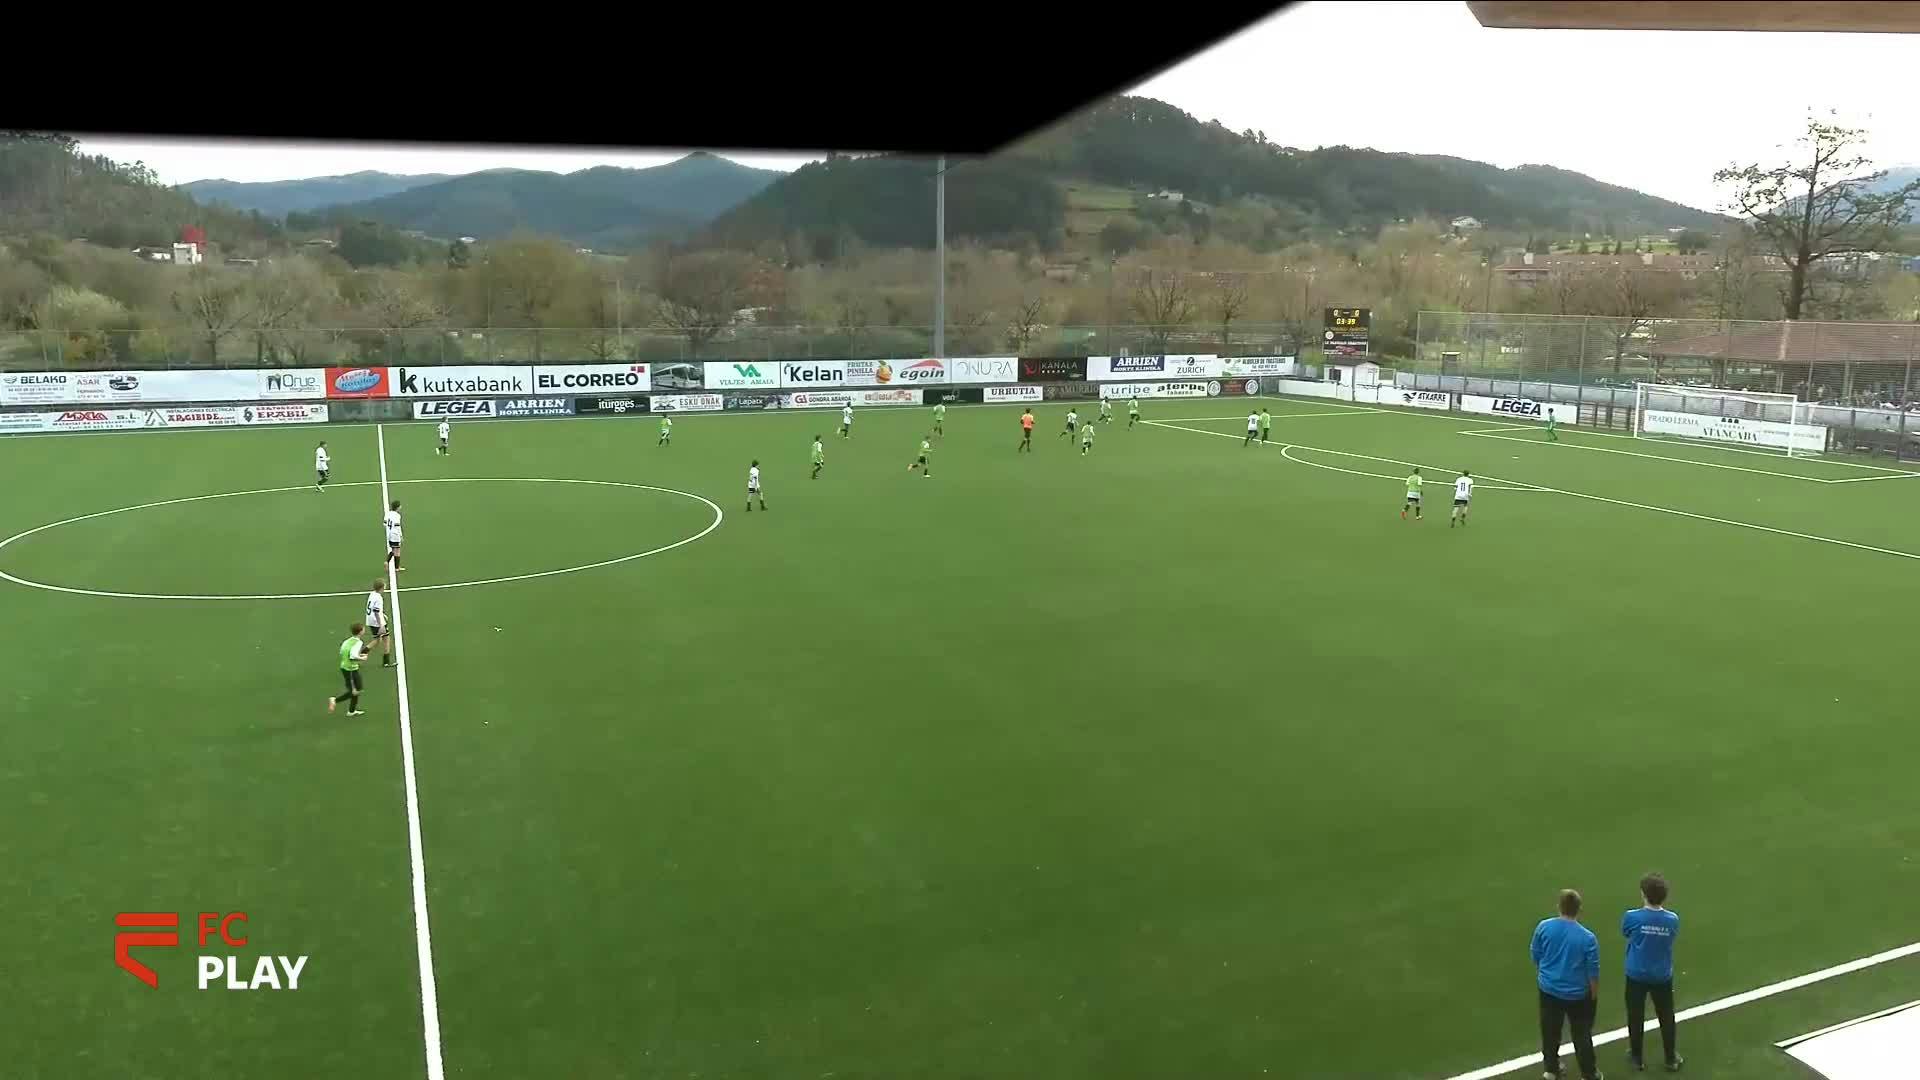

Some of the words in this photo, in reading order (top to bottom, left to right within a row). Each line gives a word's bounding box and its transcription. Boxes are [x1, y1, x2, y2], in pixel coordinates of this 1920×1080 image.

[1041, 361, 1078, 369] KANALA
[1116, 356, 1160, 366] ARRIEN
[790, 366, 843, 382] Kelan
[899, 366, 945, 381] egoin
[1176, 366, 1206, 374] ZURICH
[21, 375, 67, 384] BELAKO
[282, 374, 317, 388] Orue
[424, 375, 523, 393] kutxabank
[538, 374, 561, 388] EL
[563, 372, 639, 387] CORREO
[991, 387, 1036, 395] URRUTIA
[1111, 384, 1151, 394] uribe
[1157, 382, 1206, 392] aterpe
[679, 397, 699, 406] ESKU
[1417, 391, 1447, 402] ATXARRE
[420, 400, 492, 415] LEGEA
[505, 398, 566, 408] ARRIEN
[1491, 399, 1542, 415] LEGEA
